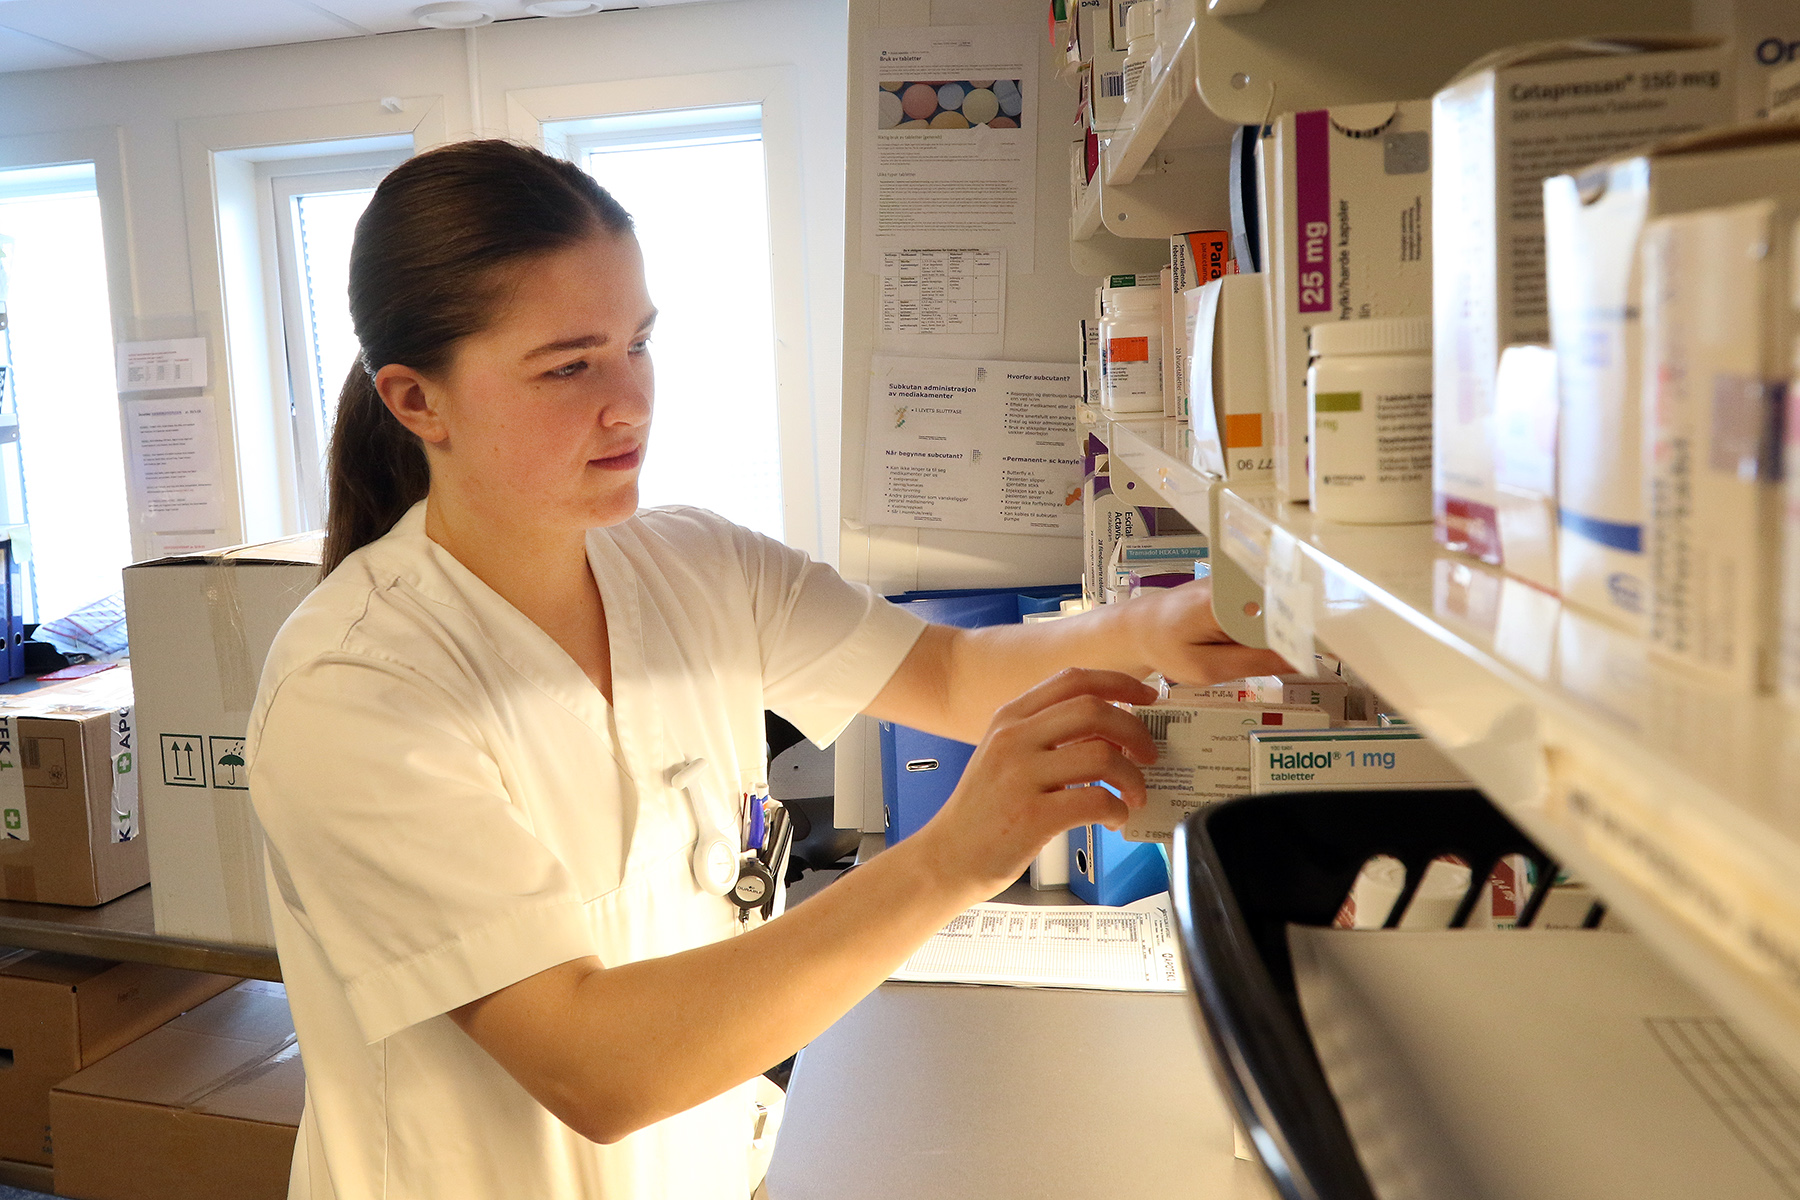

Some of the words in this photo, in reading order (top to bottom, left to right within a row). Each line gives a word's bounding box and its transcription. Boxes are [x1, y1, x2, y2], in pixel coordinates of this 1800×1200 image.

[1338, 199, 1351, 247] kapsler
[1306, 221, 1328, 264] mg
[1210, 242, 1224, 280] Para
[1302, 270, 1325, 305] 25
[1359, 303, 1370, 319] lin
[924, 385, 976, 393] administrasjon
[0, 761, 13, 771] 1
[1270, 751, 1342, 770] Haldol®
[1346, 751, 1356, 767] 1
[1363, 752, 1396, 770] mg
[1271, 772, 1315, 781] tabletter
[1171, 800, 1210, 810] primidos
[120, 810, 130, 822] 1
[119, 827, 131, 842] K
